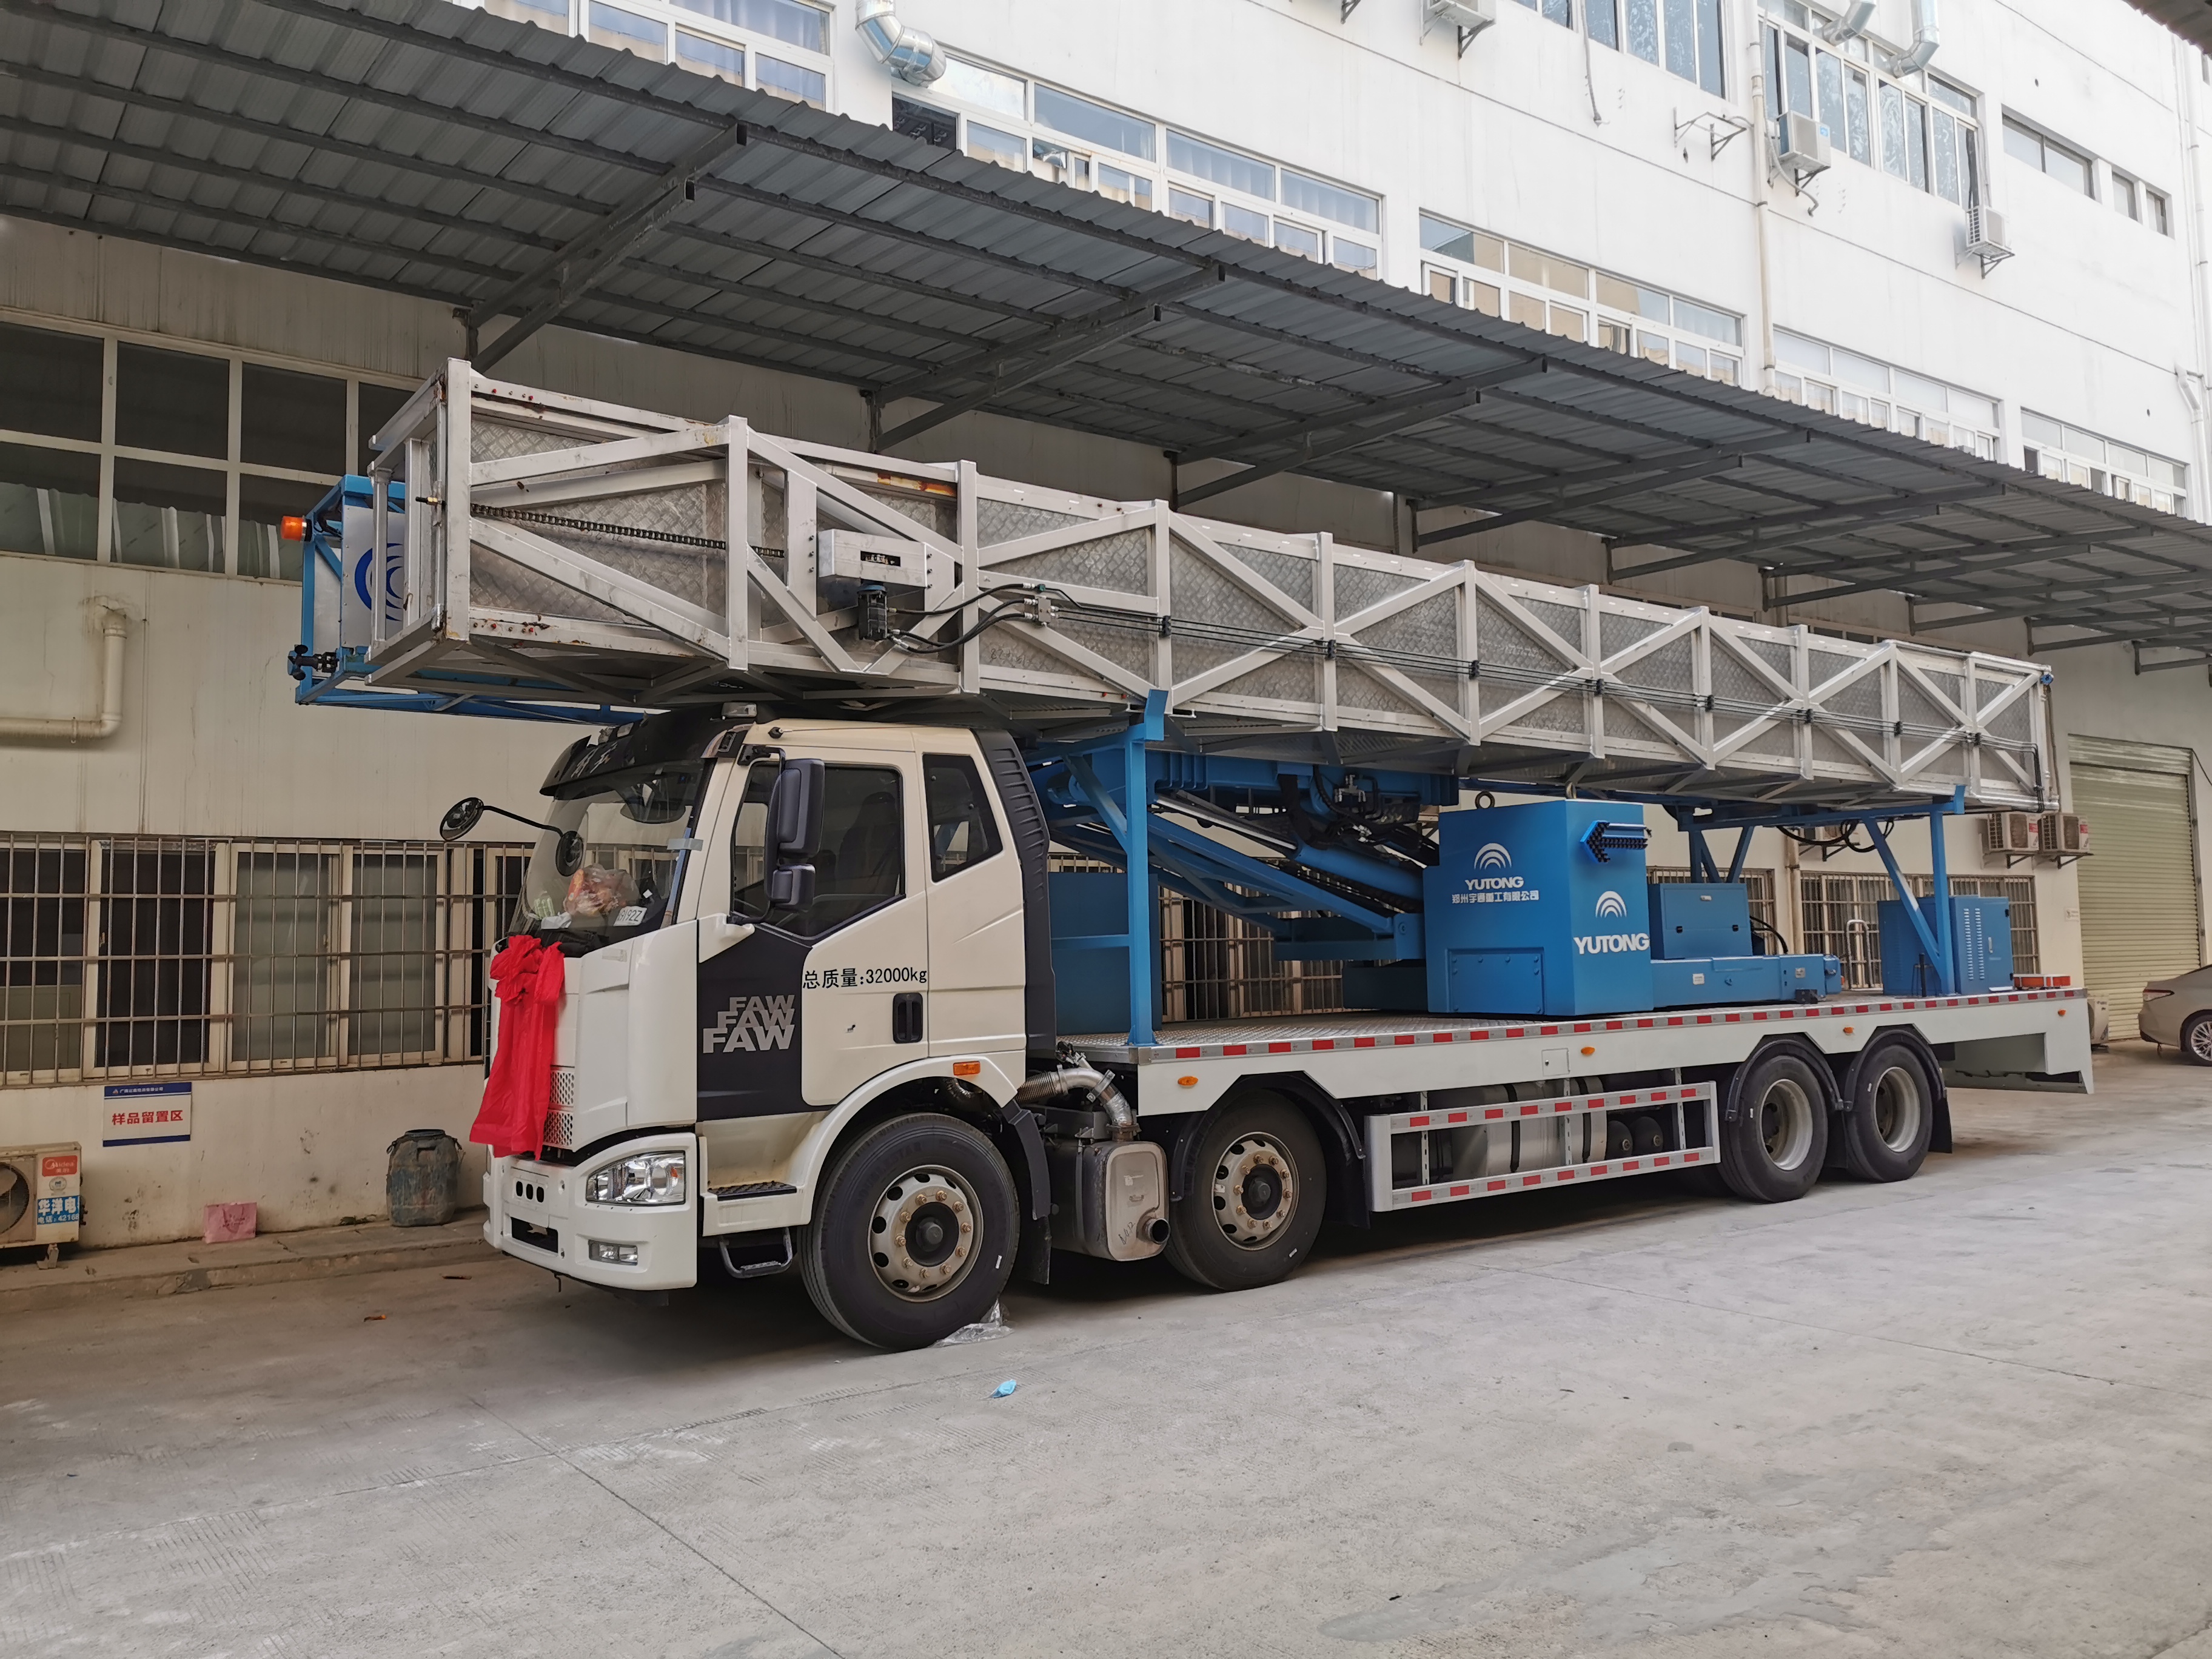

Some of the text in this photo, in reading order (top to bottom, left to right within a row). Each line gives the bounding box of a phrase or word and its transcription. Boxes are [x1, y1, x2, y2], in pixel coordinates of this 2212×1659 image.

[1464, 876, 1524, 891] YUTONG
[1452, 890, 1539, 903] 郑州宇通重工有限公司
[1573, 933, 1650, 955] YUTONG
[802, 967, 927, 990] 总质量:32000kg
[729, 994, 795, 1013] FAW
[717, 1008, 795, 1030] FAW
[703, 1024, 795, 1054] FAW
[112, 1110, 183, 1125] 样品留置区
[38, 1196, 79, 1216] 华洋电
